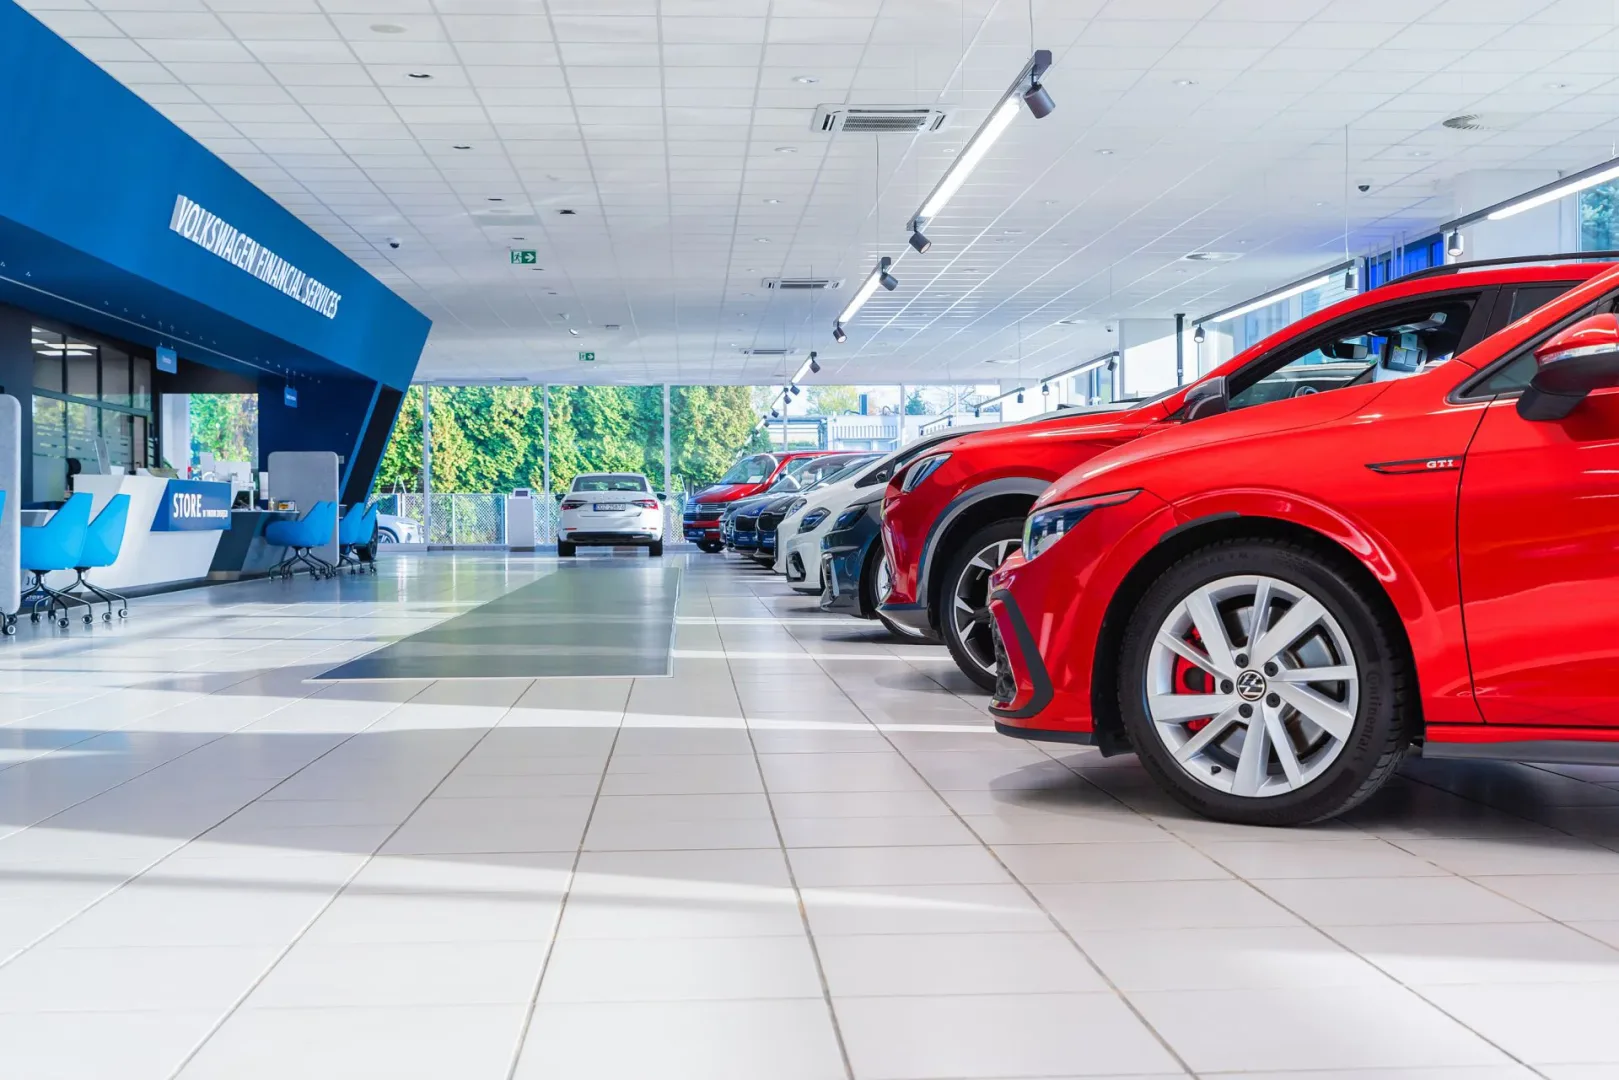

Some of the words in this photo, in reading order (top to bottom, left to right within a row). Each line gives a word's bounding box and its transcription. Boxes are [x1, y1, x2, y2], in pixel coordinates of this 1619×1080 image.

[175, 195, 260, 274] VOLKSWAGEN
[254, 246, 306, 300] FINANCIAL
[301, 277, 342, 320] SERVICES
[1426, 459, 1454, 469] GTI
[173, 492, 202, 518] STORE
[1356, 669, 1382, 752] Continental
